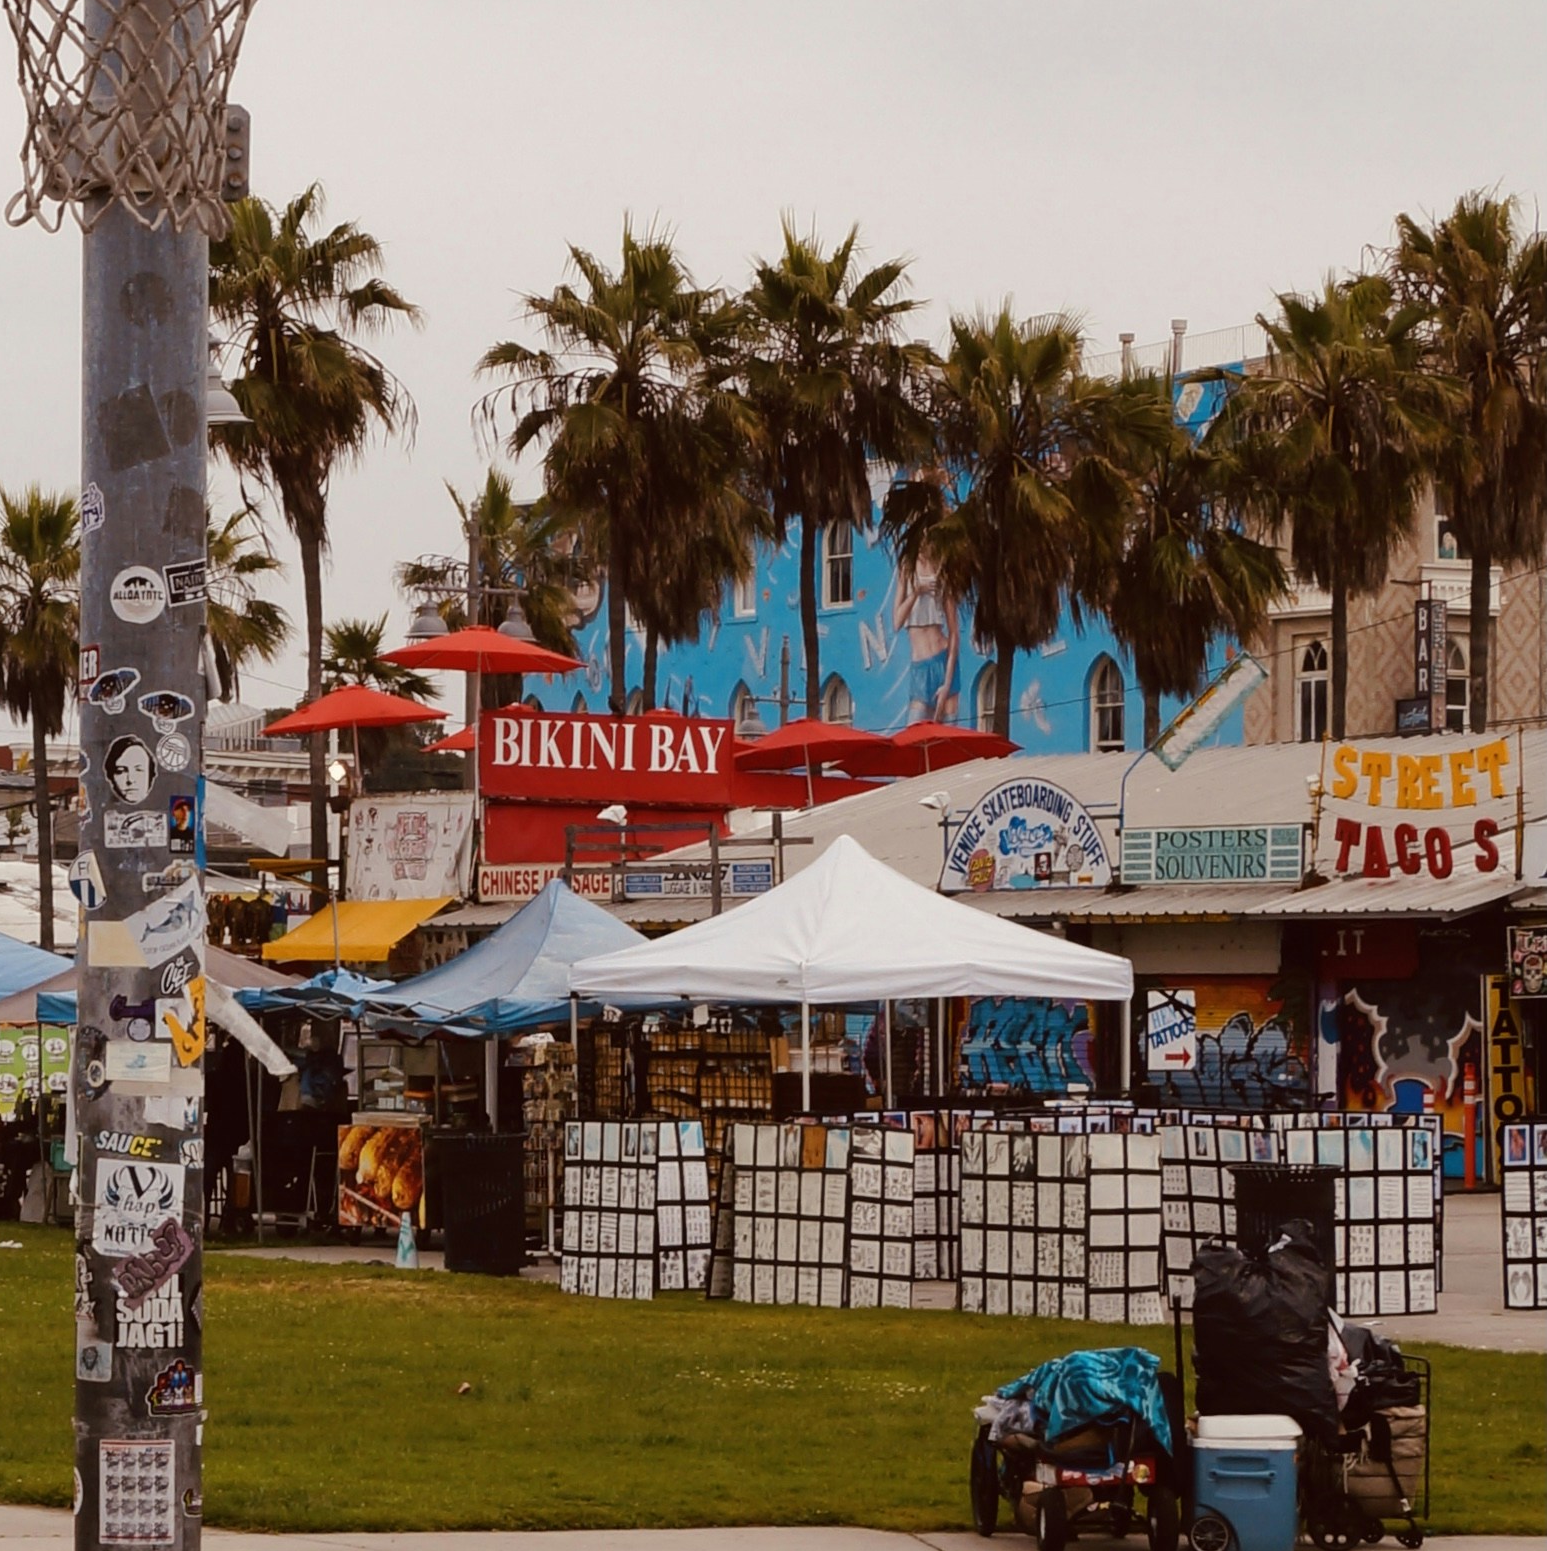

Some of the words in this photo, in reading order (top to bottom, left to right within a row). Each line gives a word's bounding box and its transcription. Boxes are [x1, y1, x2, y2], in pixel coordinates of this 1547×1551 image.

[1418, 607, 1429, 692] BAR
[492, 717, 636, 771] BIKINI
[647, 724, 726, 774] BAY
[1332, 738, 1510, 809] STREET
[949, 815, 985, 875] VENICE
[982, 784, 1073, 827] SKATEBOARDING
[1073, 814, 1105, 868] STUFF
[1156, 828, 1268, 849] POSTERS
[481, 870, 539, 896] CHINESE
[1155, 853, 1267, 881] SOUVENIRS
[1149, 1015, 1196, 1049] TATTOOS
